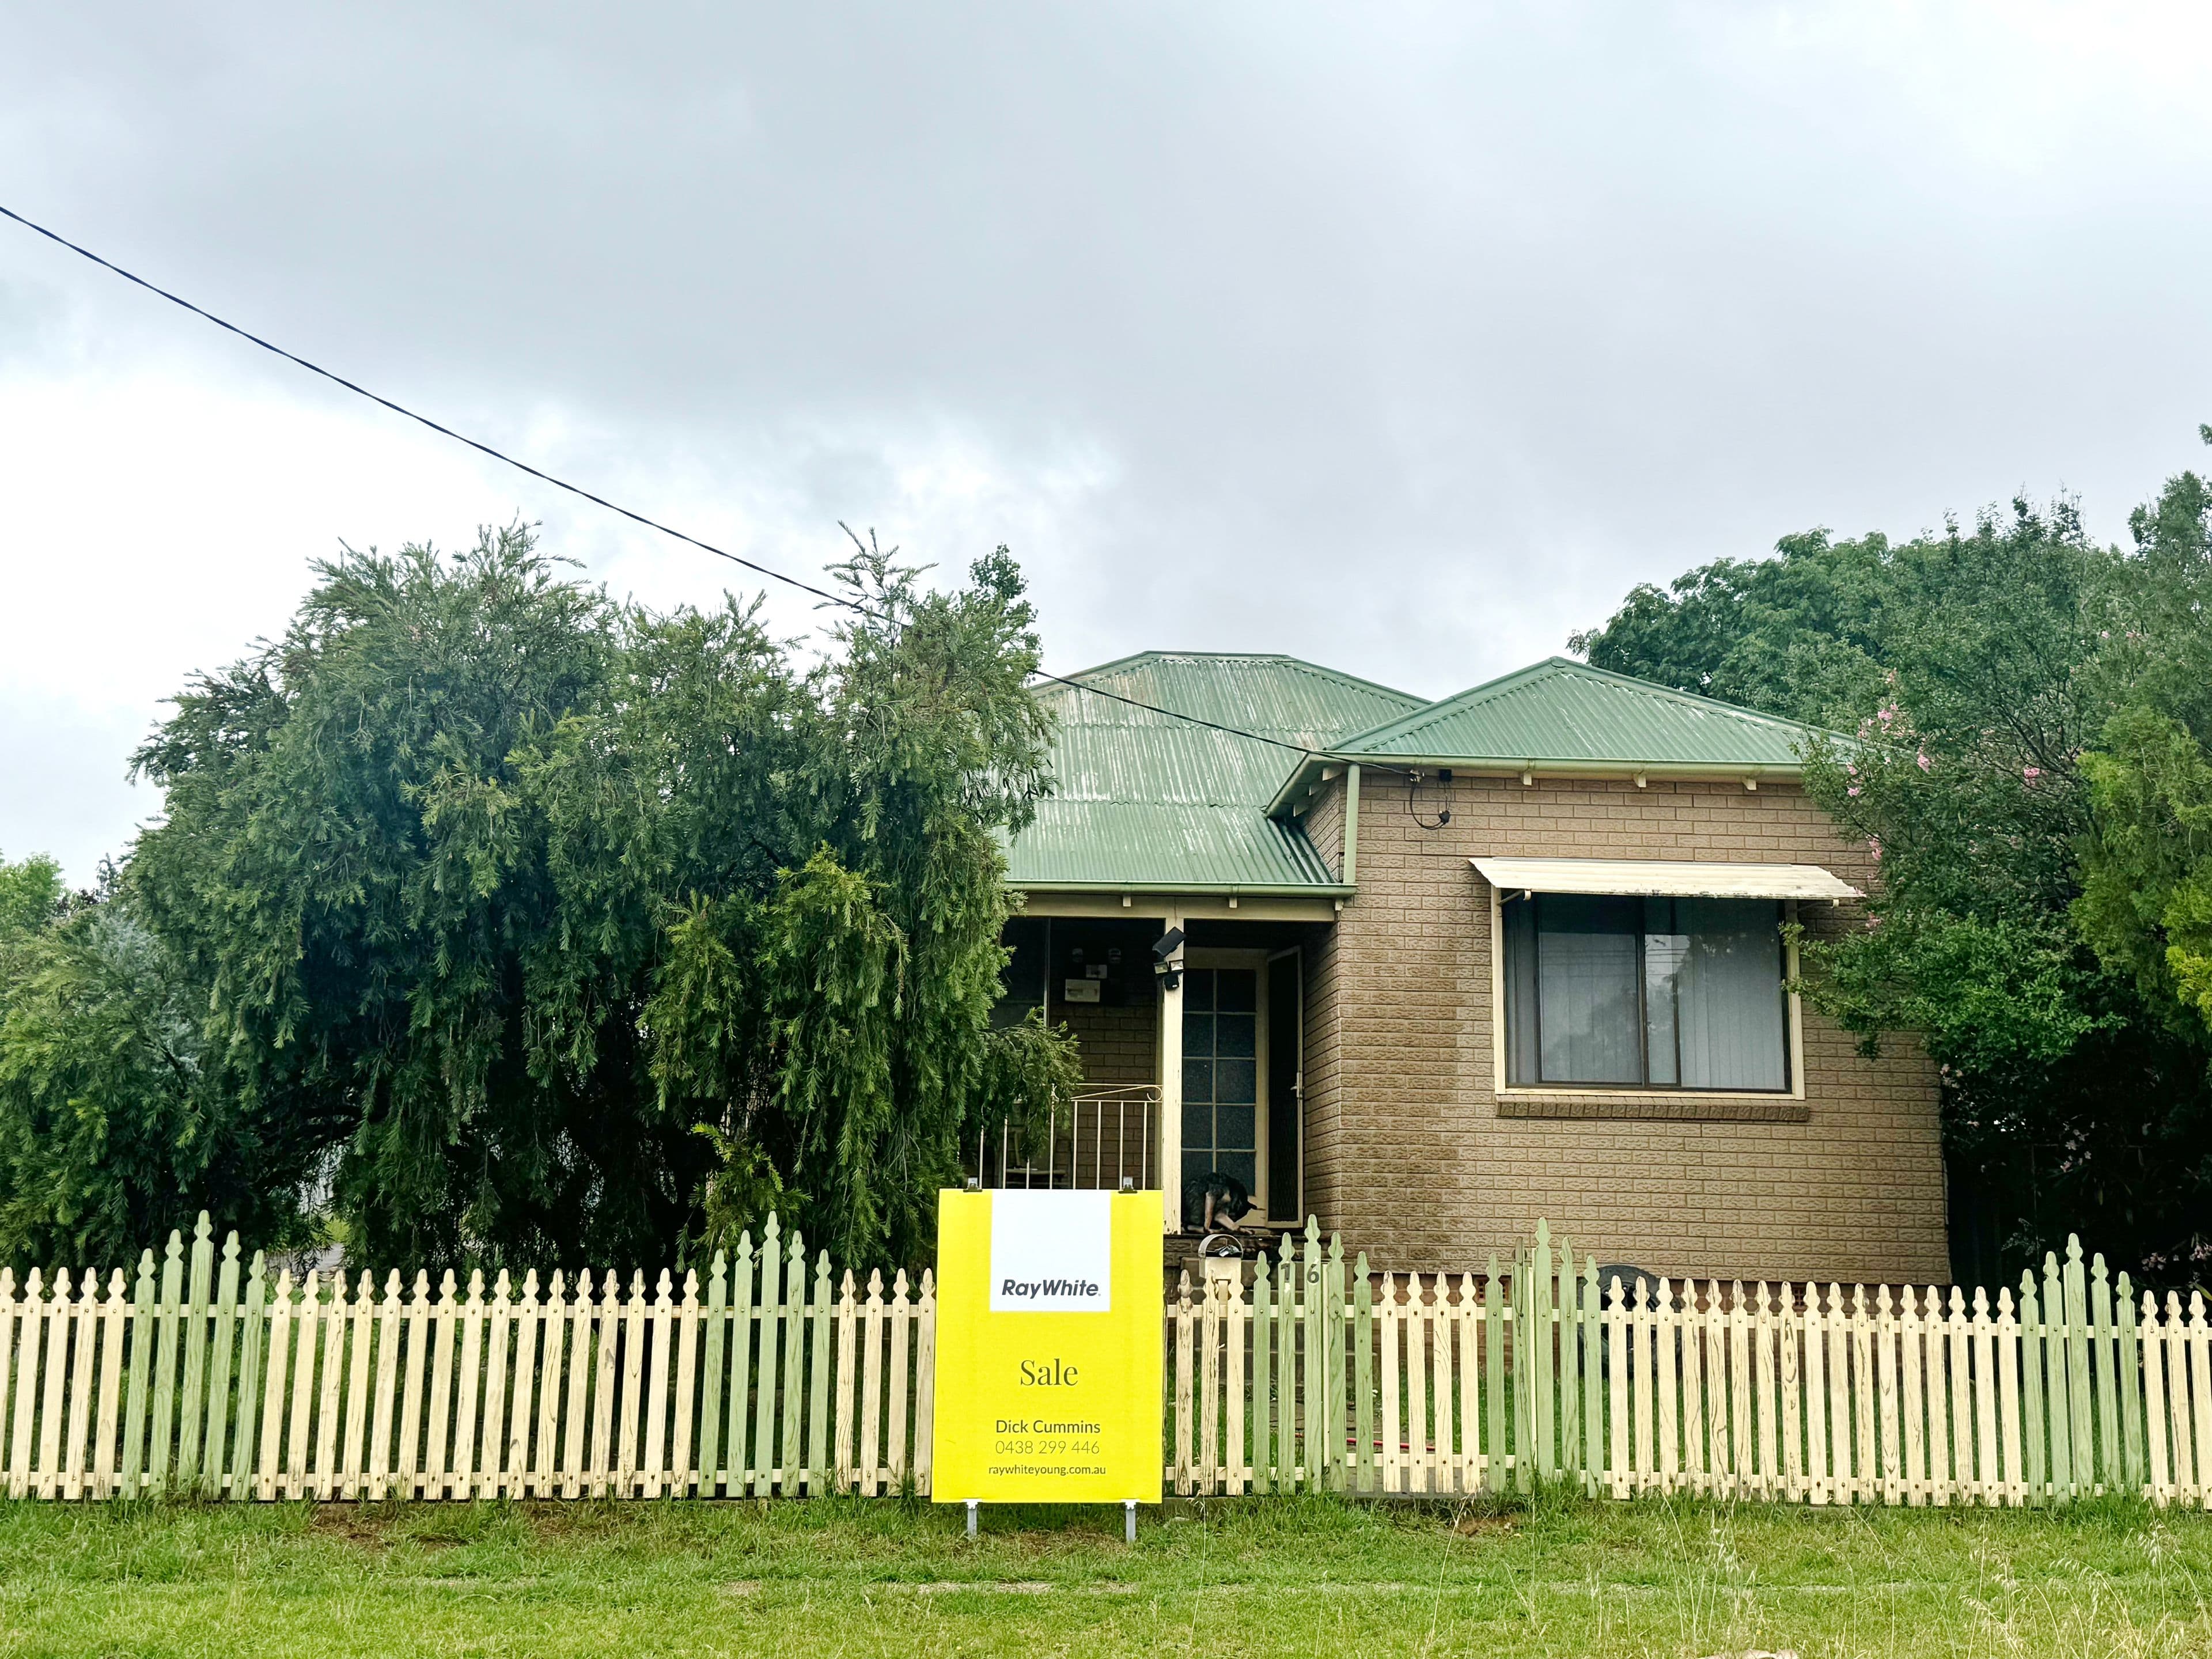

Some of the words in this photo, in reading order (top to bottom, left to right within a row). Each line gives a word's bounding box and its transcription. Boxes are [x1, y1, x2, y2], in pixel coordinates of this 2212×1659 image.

[1020, 1358, 1078, 1386] Sale
[996, 1419, 1028, 1433] Dick
[1033, 1420, 1100, 1433] Cummins
[996, 1441, 1033, 1454] 0438
[1039, 1441, 1066, 1454] 299
[1071, 1441, 1099, 1455] 446
[988, 1464, 1105, 1476] raywhiteyoung.com.au
